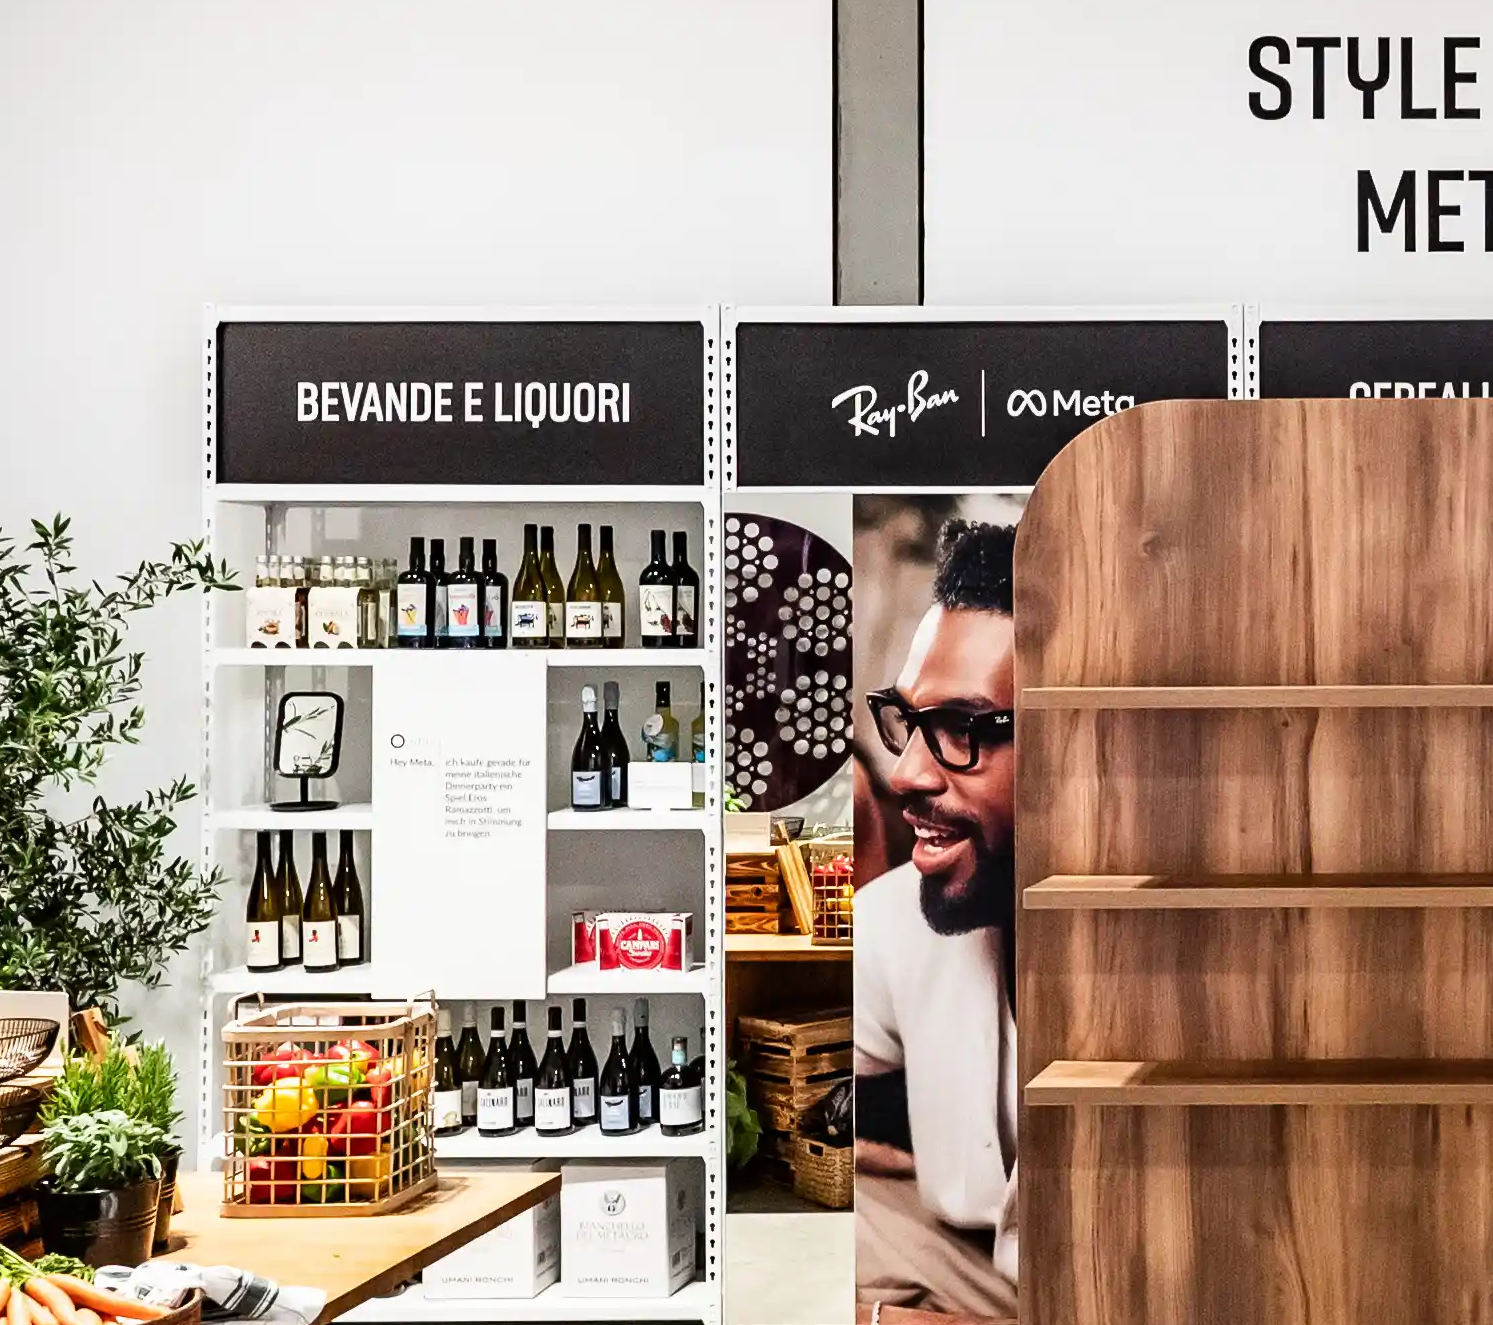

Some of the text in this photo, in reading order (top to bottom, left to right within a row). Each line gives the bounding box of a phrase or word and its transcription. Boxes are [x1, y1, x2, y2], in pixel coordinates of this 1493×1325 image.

[1249, 36, 1480, 120] STYLE
[298, 382, 629, 428] BEVANDE E LIQUORI
[832, 370, 1135, 437] Ray-Ban Meta
[390, 758, 407, 767] Hey
[487, 758, 516, 768] gerade
[478, 818, 522, 827] Stimmung
